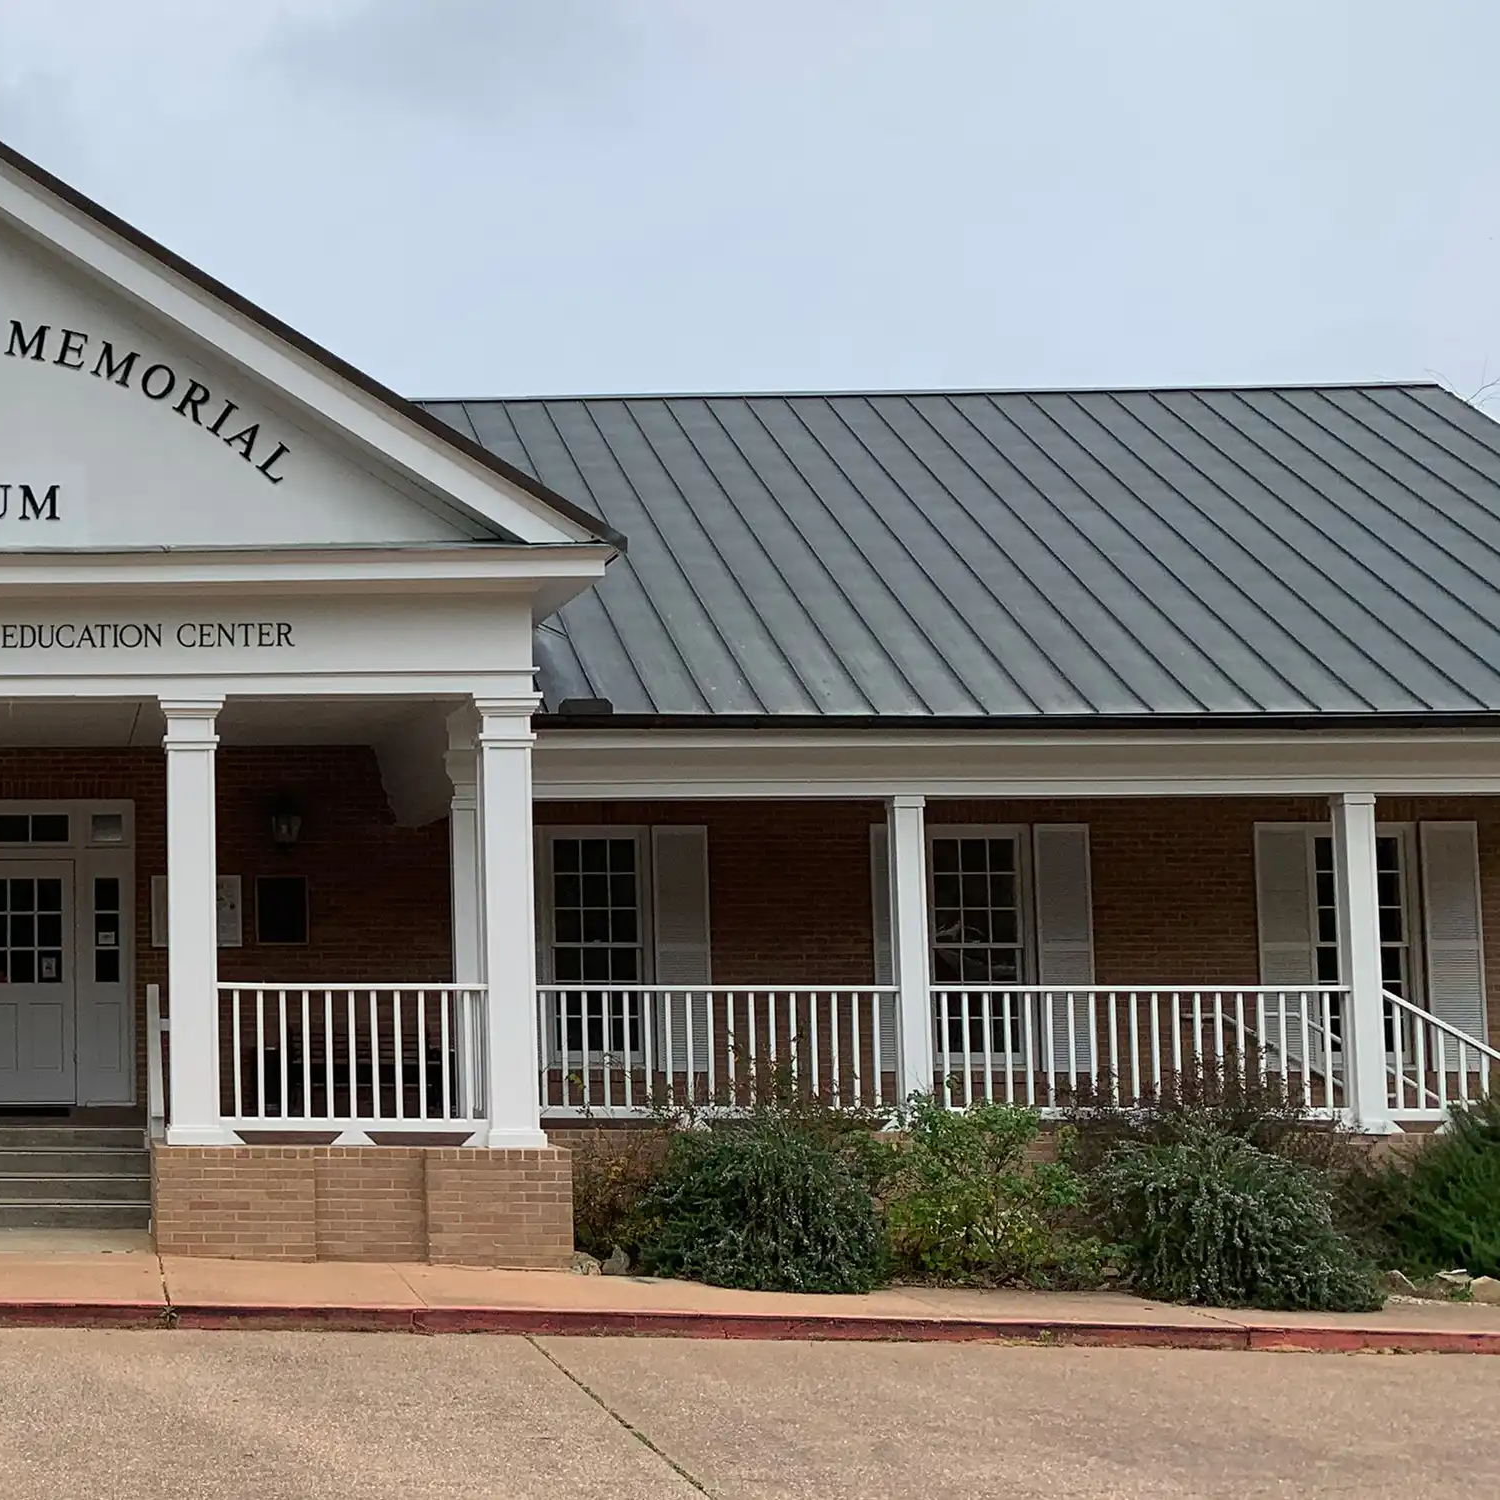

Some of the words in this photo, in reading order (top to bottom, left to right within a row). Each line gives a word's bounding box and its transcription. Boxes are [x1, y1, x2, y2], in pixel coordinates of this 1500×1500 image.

[3, 319, 293, 485] MEMORIAL
[1, 623, 163, 649] EDUCATION
[177, 622, 296, 648] CENTER
